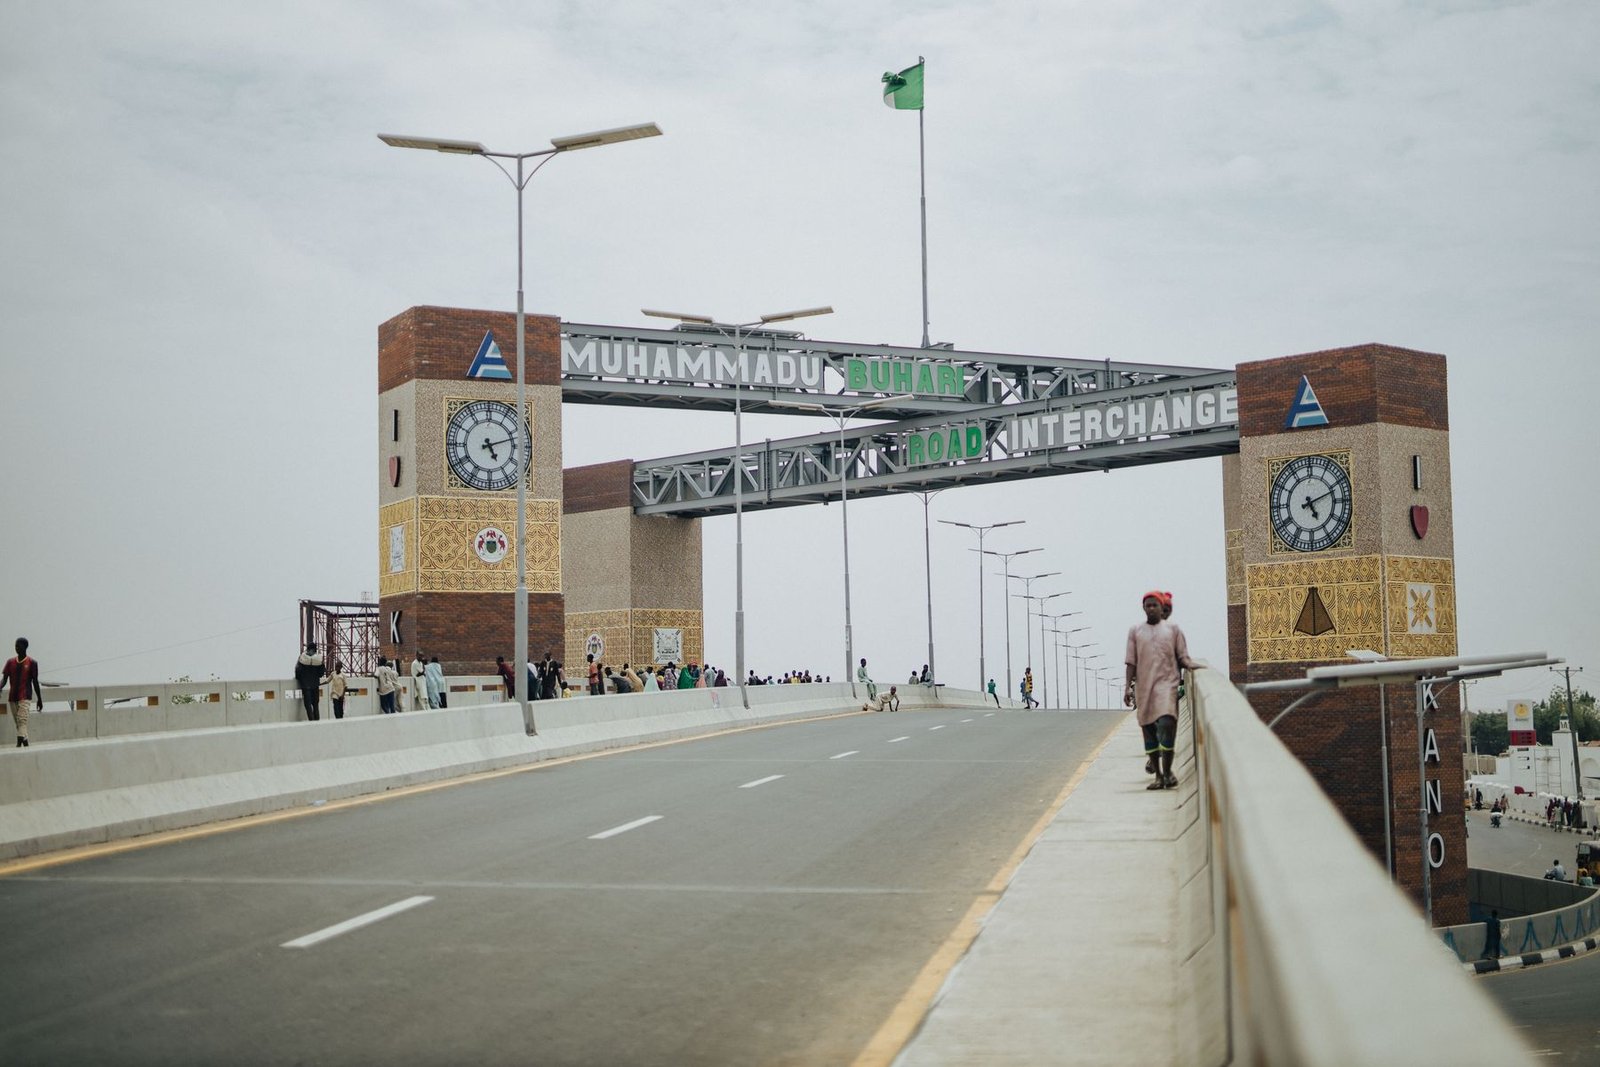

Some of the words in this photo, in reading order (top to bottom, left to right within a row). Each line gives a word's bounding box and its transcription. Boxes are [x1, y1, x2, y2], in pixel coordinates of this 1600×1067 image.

[561, 340, 820, 386] MUHAMMADU
[848, 359, 964, 395] BUHARI
[908, 426, 982, 465] ROAD
[1011, 389, 1239, 450] INTERCHANGE
[1422, 676, 1445, 868] KANO
